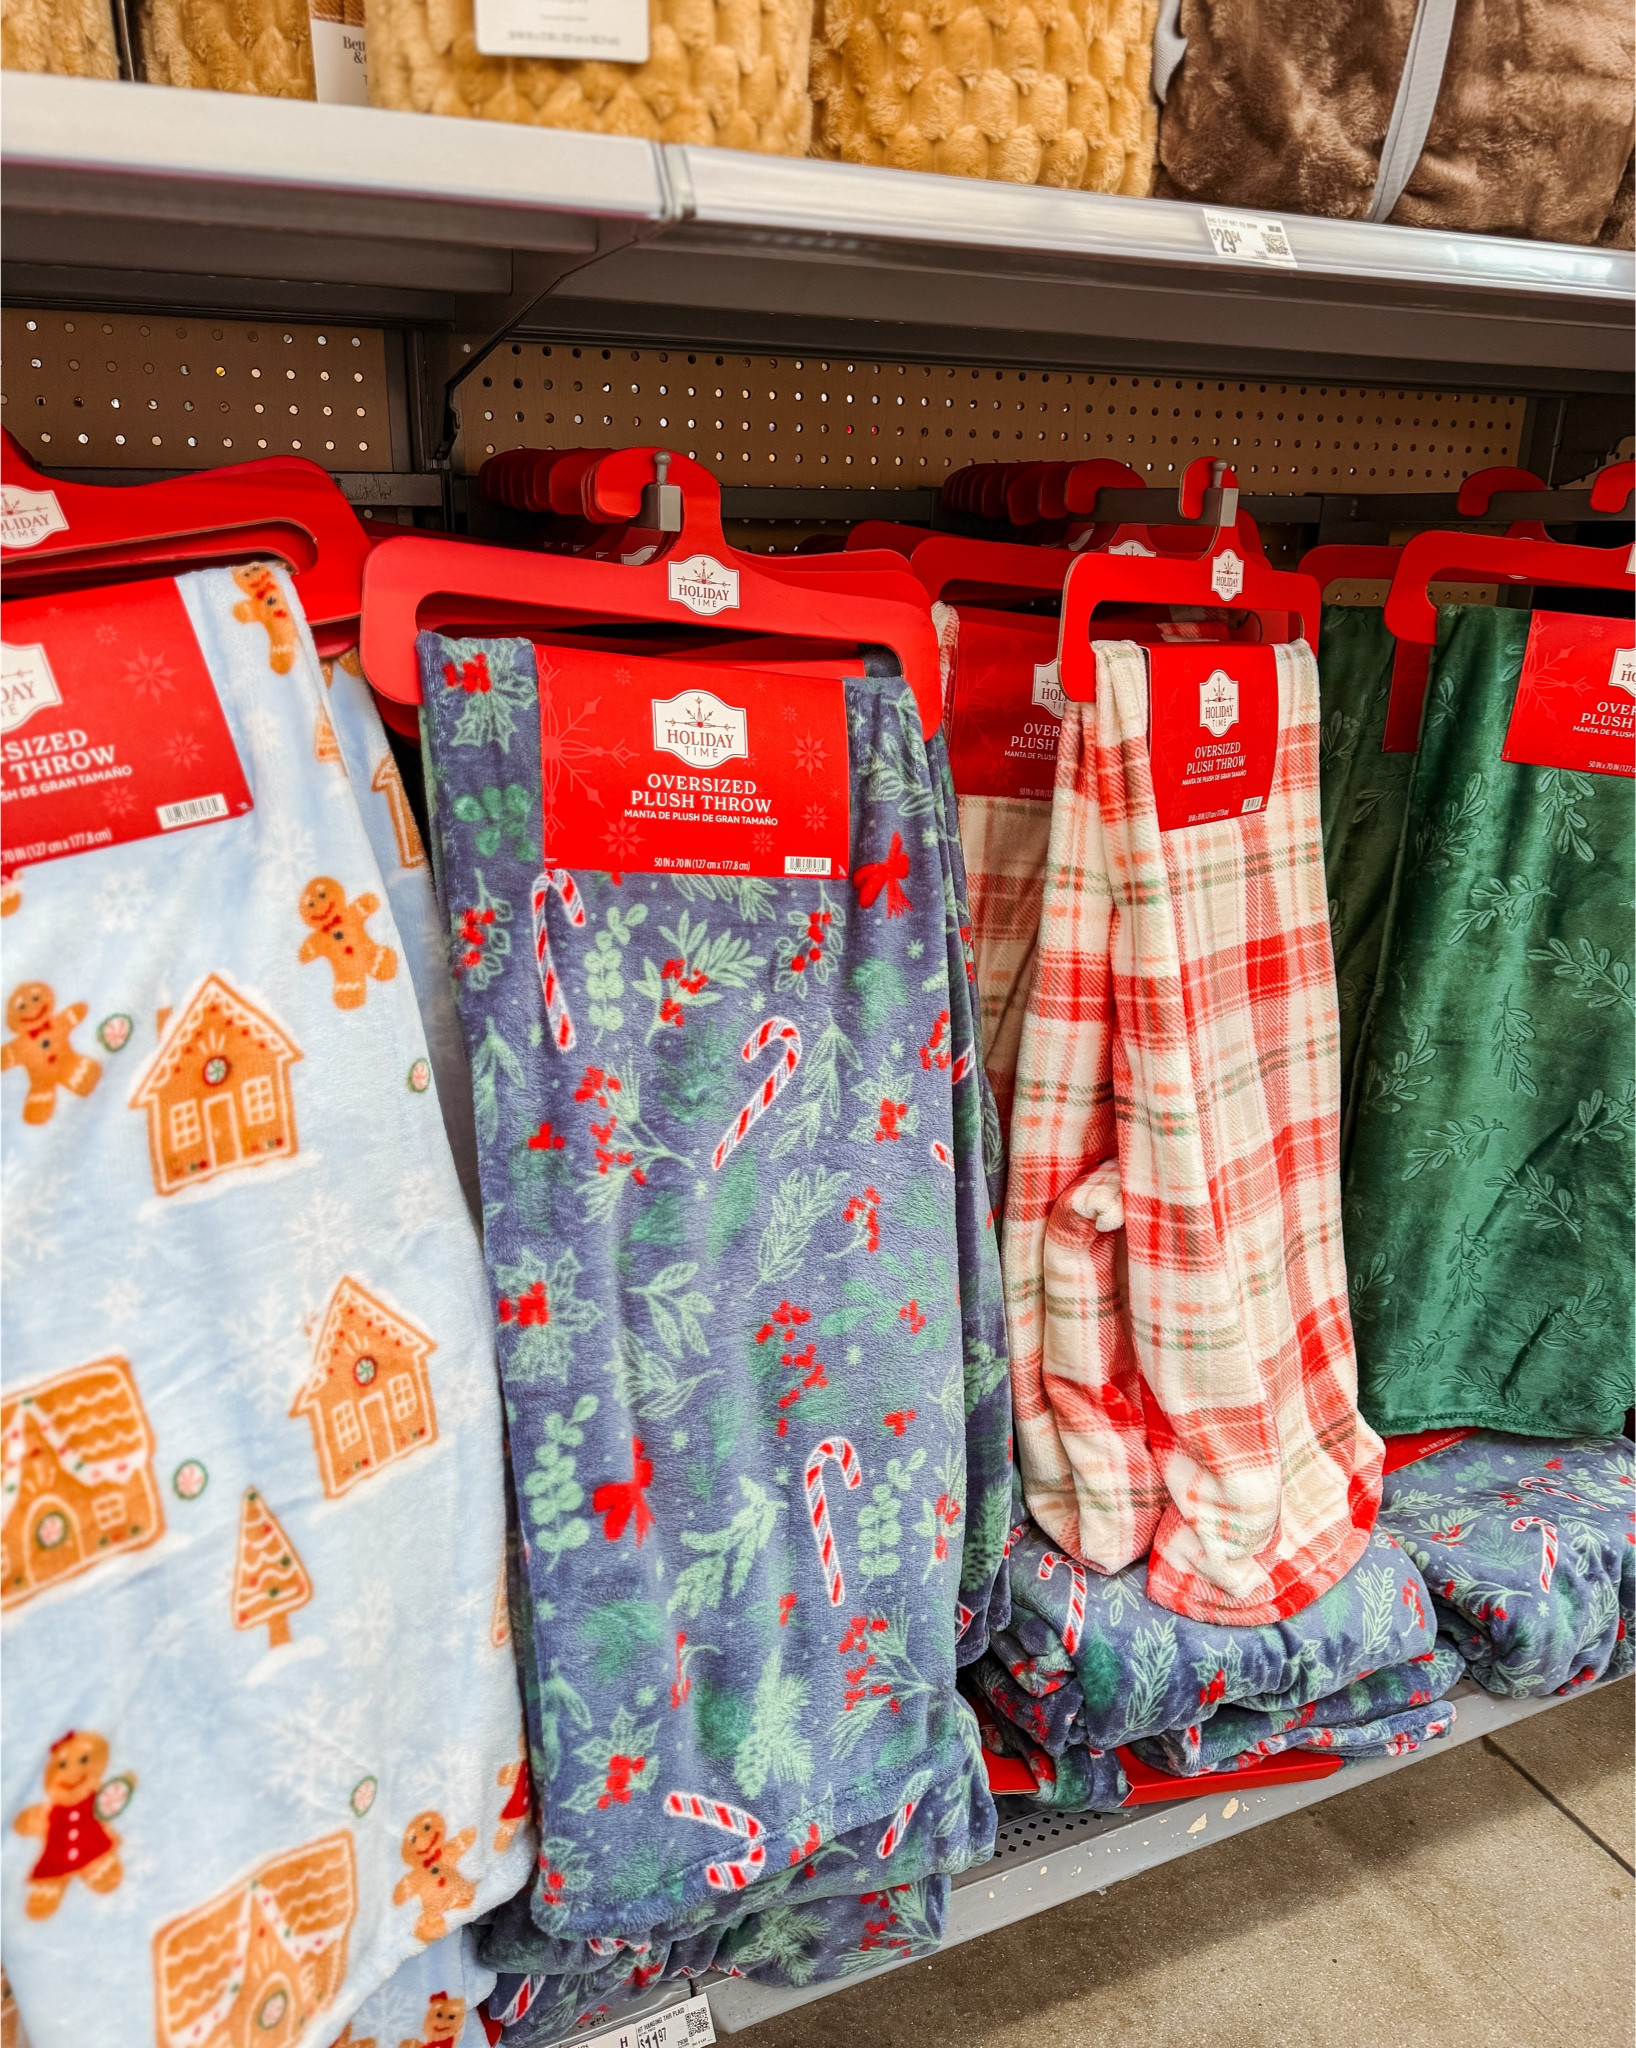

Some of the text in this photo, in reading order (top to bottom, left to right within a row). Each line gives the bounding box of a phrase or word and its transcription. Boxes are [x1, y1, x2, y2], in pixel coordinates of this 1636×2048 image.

[1, 513, 50, 532] LIDAY
[2, 528, 38, 540] TIME
[1216, 576, 1238, 588] HOLIDAY
[1221, 586, 1233, 594] TIME
[678, 584, 729, 601] HOLIDAY
[691, 598, 717, 608] TIME
[1205, 704, 1234, 719] HOLIDAY
[1212, 718, 1227, 727] TIME
[1580, 712, 1634, 729] PLUSH
[667, 729, 735, 748] HOLIDAY
[1572, 725, 1635, 739] MANTA DE PLUSH
[1, 729, 88, 763] SIZED
[684, 745, 718, 758] TIME
[1010, 735, 1055, 751] PLUSH
[1194, 741, 1241, 759] OVERSIZED
[9, 744, 115, 782] THROW
[1004, 750, 1057, 761] MANTA DE PLUSH
[1186, 755, 1246, 775] PLUSH THROW
[20, 784, 39, 799] DE
[40, 777, 77, 794] GRAN
[78, 765, 132, 785] TAMAÑO
[647, 773, 757, 795] OVERSIZED
[1181, 777, 1196, 786] MANTA
[631, 790, 773, 813] PLUSH THROW
[624, 809, 778, 826] MANTA DE PLUSH DE GRAN TAMAÑO
[14, 846, 27, 861] IN
[27, 842, 46, 859] (127
[48, 840, 62, 854] cm
[63, 839, 70, 851] x
[95, 827, 112, 844] cm)
[654, 857, 663, 867] 50
[663, 858, 670, 867] IN
[675, 858, 684, 868] 70
[684, 858, 692, 868] IN
[692, 859, 707, 869] (127
[706, 861, 716, 869] cm
[722, 860, 739, 871] 177.8
[738, 861, 751, 872] cm)
[643, 2017, 663, 2030] HANGING
[672, 2007, 685, 2018] PLAID
[620, 2036, 628, 2048] H
